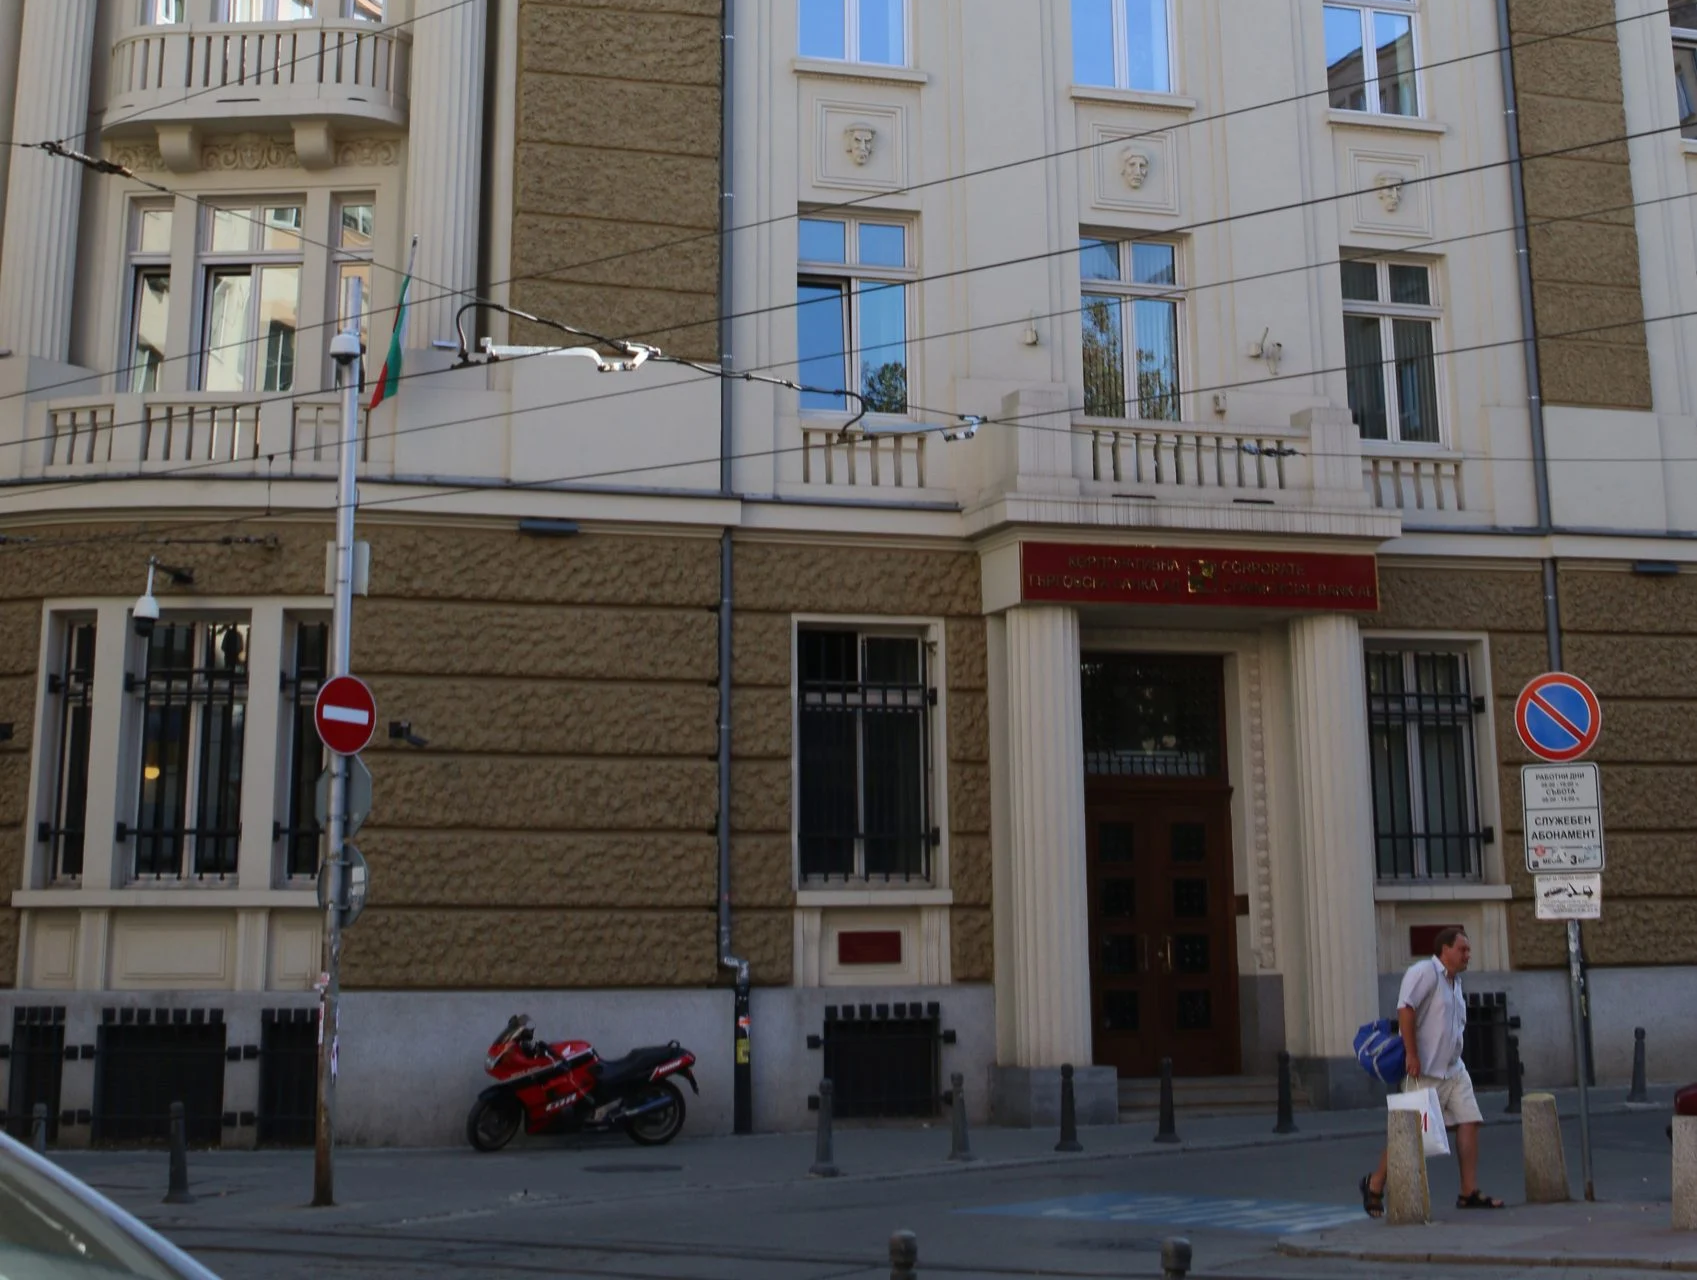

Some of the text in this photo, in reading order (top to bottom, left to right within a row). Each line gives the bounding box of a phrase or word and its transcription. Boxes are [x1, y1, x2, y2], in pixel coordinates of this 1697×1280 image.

[1068, 554, 1181, 572] КОРПОРАТИВНА
[1221, 559, 1305, 577] CORPORATE
[1317, 583, 1355, 599] BANK
[1535, 771, 1585, 781] РАБОТНИ ДНИ
[1546, 787, 1576, 796] СЪБОТА
[1534, 815, 1592, 826] СЛУЖЕБЕН
[1531, 829, 1596, 840] АБОНАМЕНТ
[1570, 854, 1577, 866] 3
